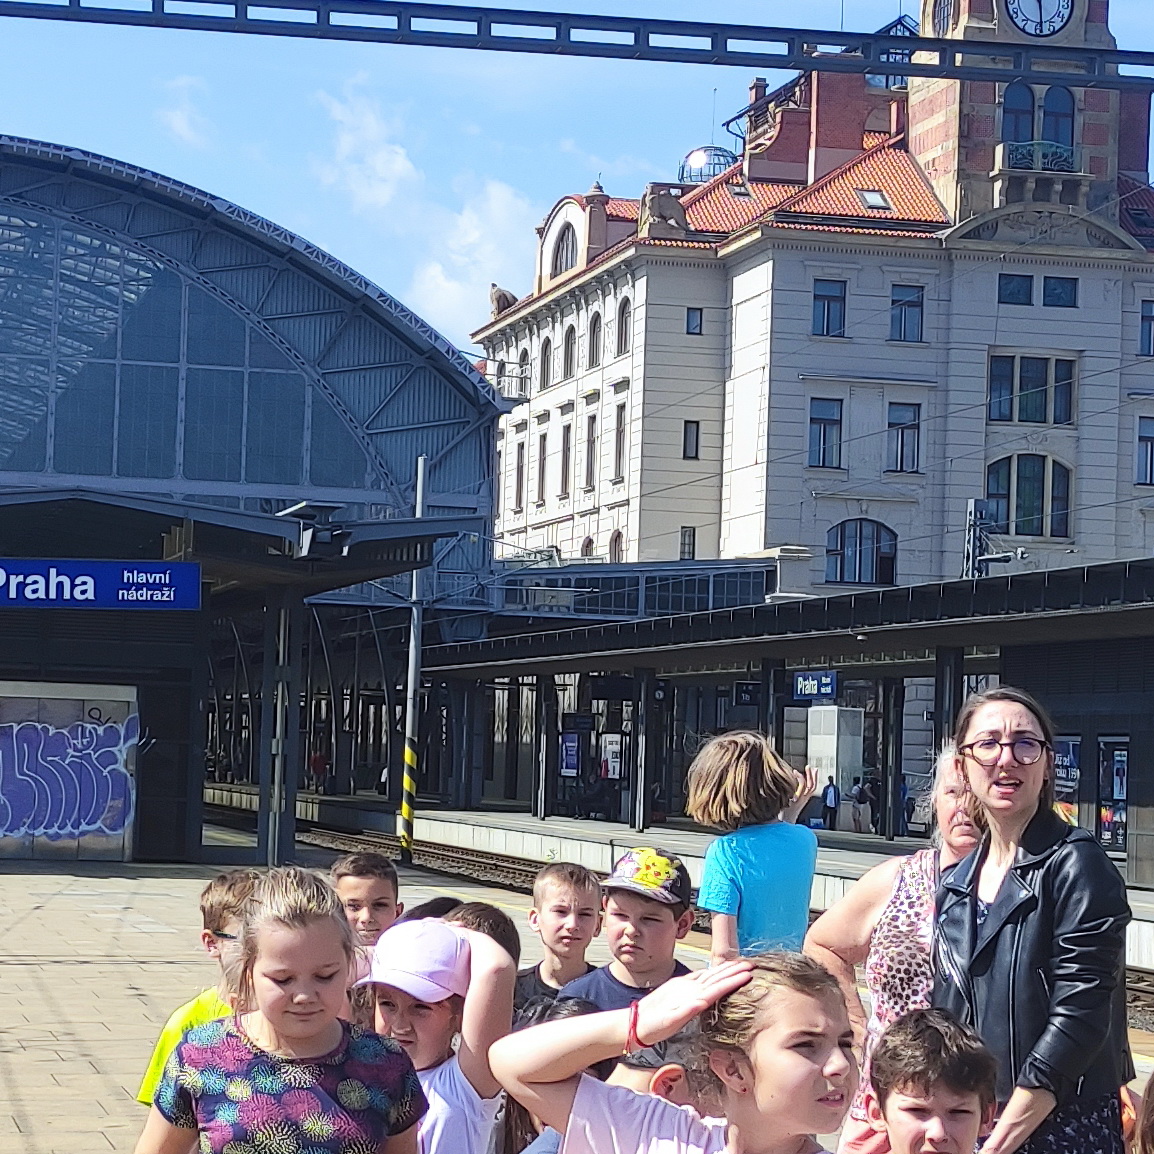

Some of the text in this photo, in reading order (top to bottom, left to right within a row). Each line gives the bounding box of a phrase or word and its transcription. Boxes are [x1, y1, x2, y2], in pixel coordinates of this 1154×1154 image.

[0, 567, 96, 601] raha
[123, 569, 172, 584] hlavní
[118, 586, 176, 602] nádraží
[797, 675, 818, 695] Praha
